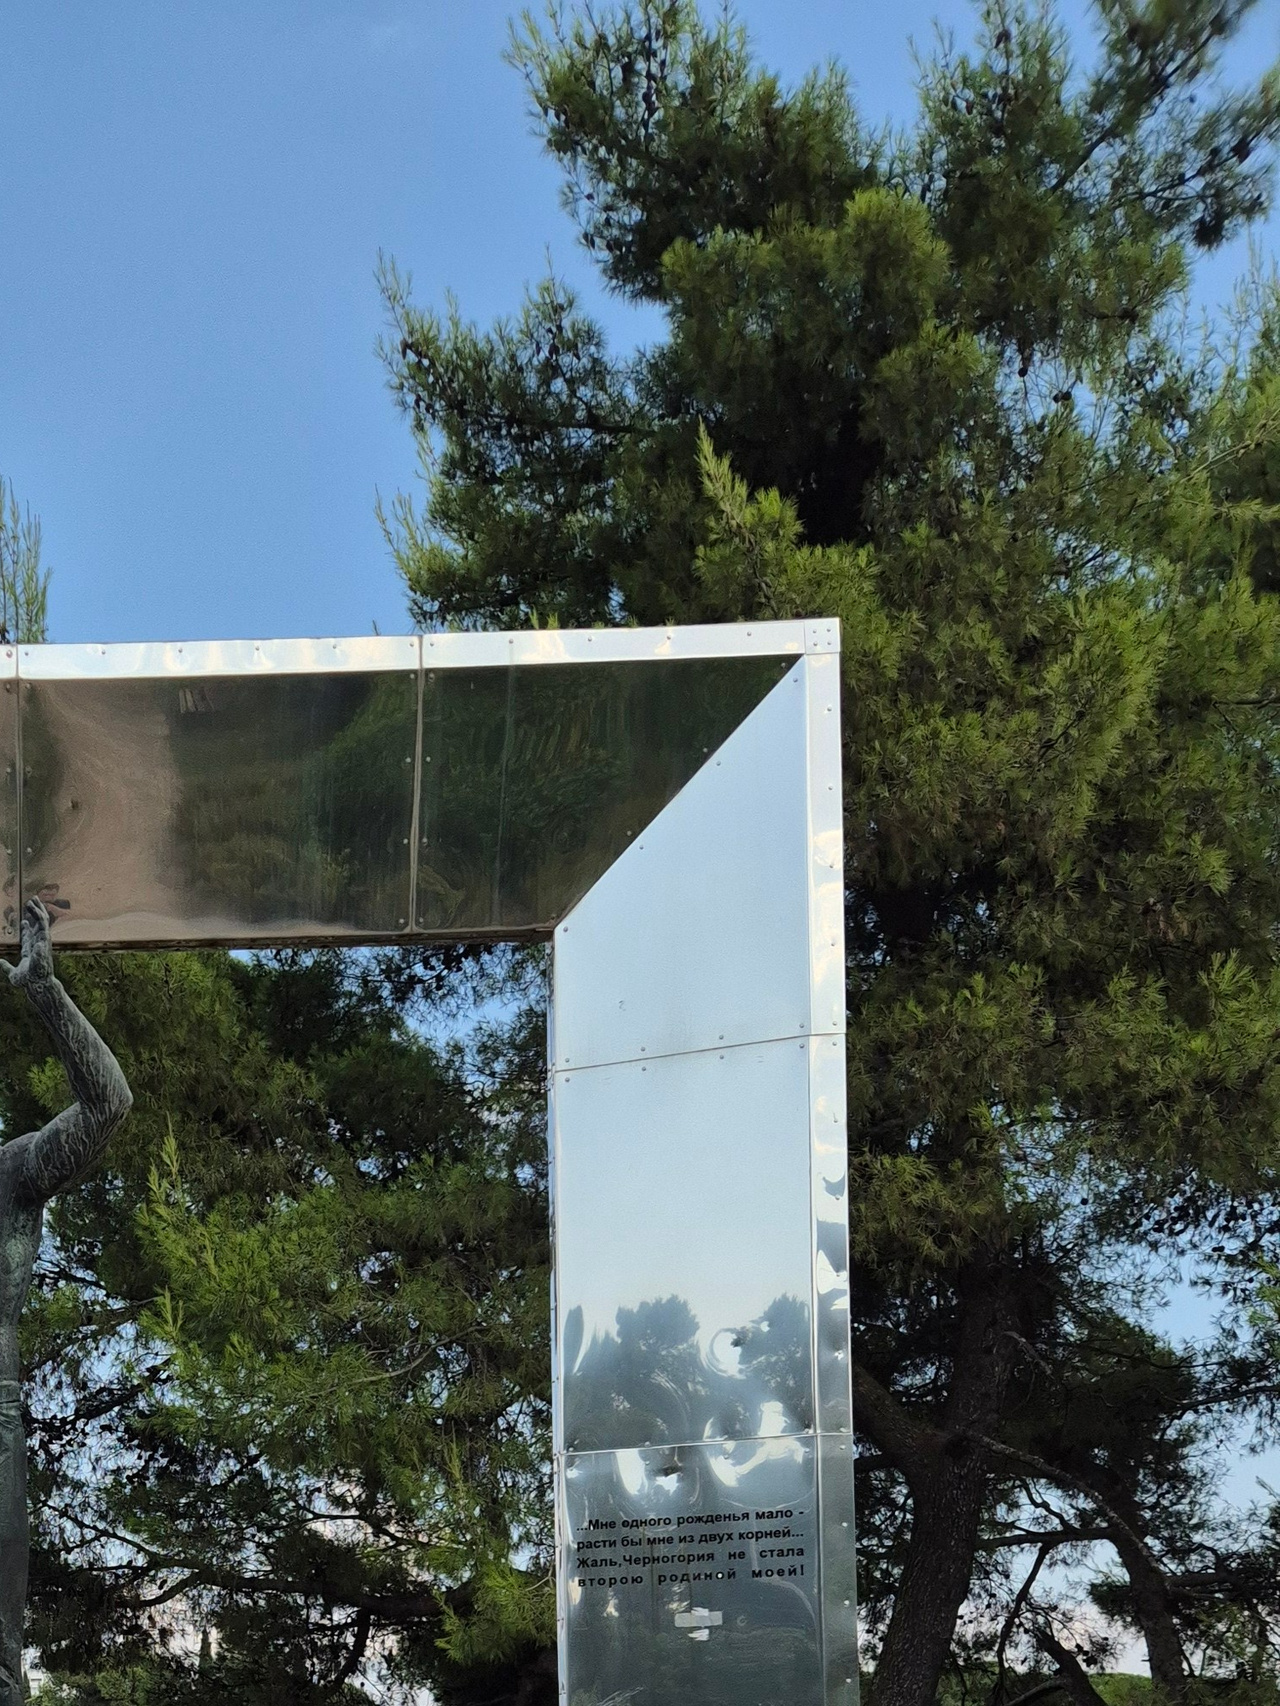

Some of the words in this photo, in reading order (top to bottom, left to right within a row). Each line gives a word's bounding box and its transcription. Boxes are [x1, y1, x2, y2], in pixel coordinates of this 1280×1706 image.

[622, 1516, 671, 1531] одного
[677, 1511, 749, 1526] рожденья
[755, 1509, 793, 1520] мало
[576, 1538, 617, 1552] расти
[621, 1536, 642, 1547] бы
[647, 1535, 674, 1545] мне
[678, 1534, 695, 1543] из
[698, 1531, 733, 1545] двух
[728, 1550, 746, 1560] не
[759, 1547, 804, 1559] стала
[578, 1574, 644, 1587] второю
[658, 1568, 736, 1585] родиной
[752, 1565, 804, 1579] моей!
